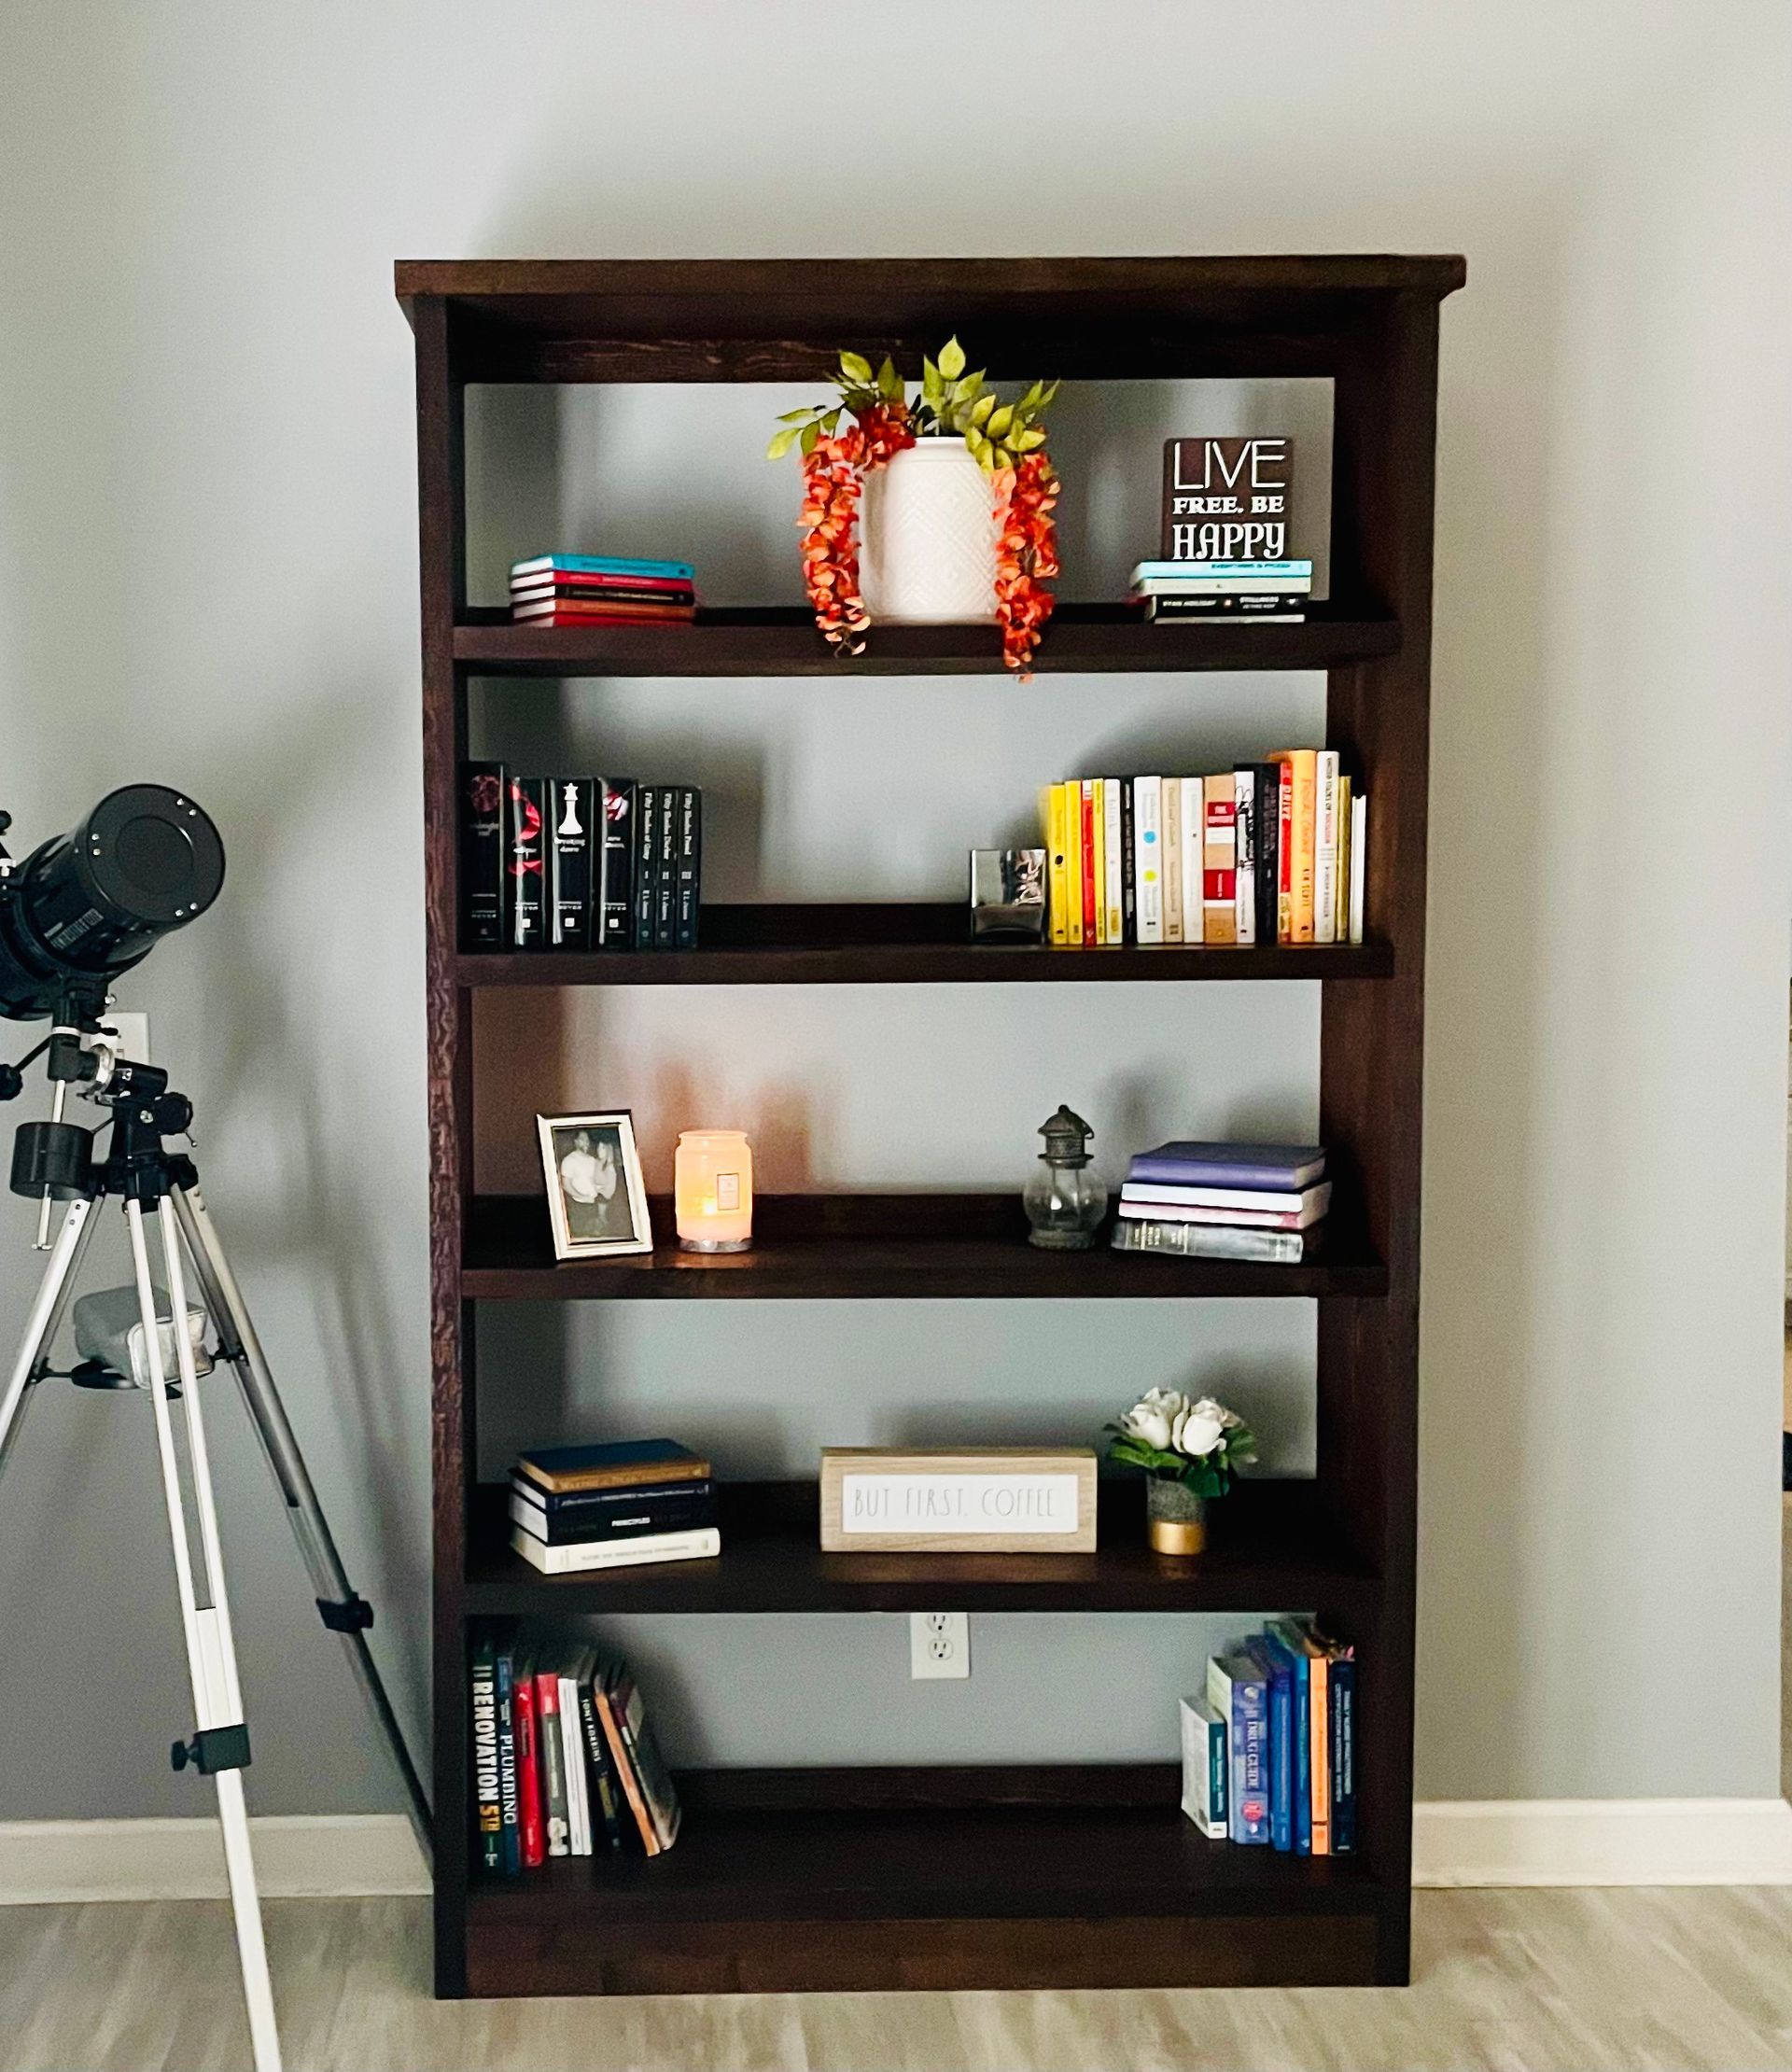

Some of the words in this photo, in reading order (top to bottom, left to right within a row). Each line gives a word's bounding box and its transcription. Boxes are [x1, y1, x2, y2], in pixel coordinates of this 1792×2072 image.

[1174, 439, 1286, 490] LIVE
[1172, 497, 1244, 515] FREE.
[1251, 496, 1284, 514] BE
[1172, 522, 1285, 560] HAPPY
[854, 1488, 891, 1517] BUT
[981, 1487, 1055, 1517] COFFEE
[581, 1698, 594, 1722] TONY
[472, 1681, 499, 1801] RENOVATION
[586, 1723, 602, 1763] ROBBINS
[1246, 1720, 1259, 1752] DRUG
[499, 1733, 517, 1825] PLUMBING
[1246, 1753, 1259, 1789] GUIDE
